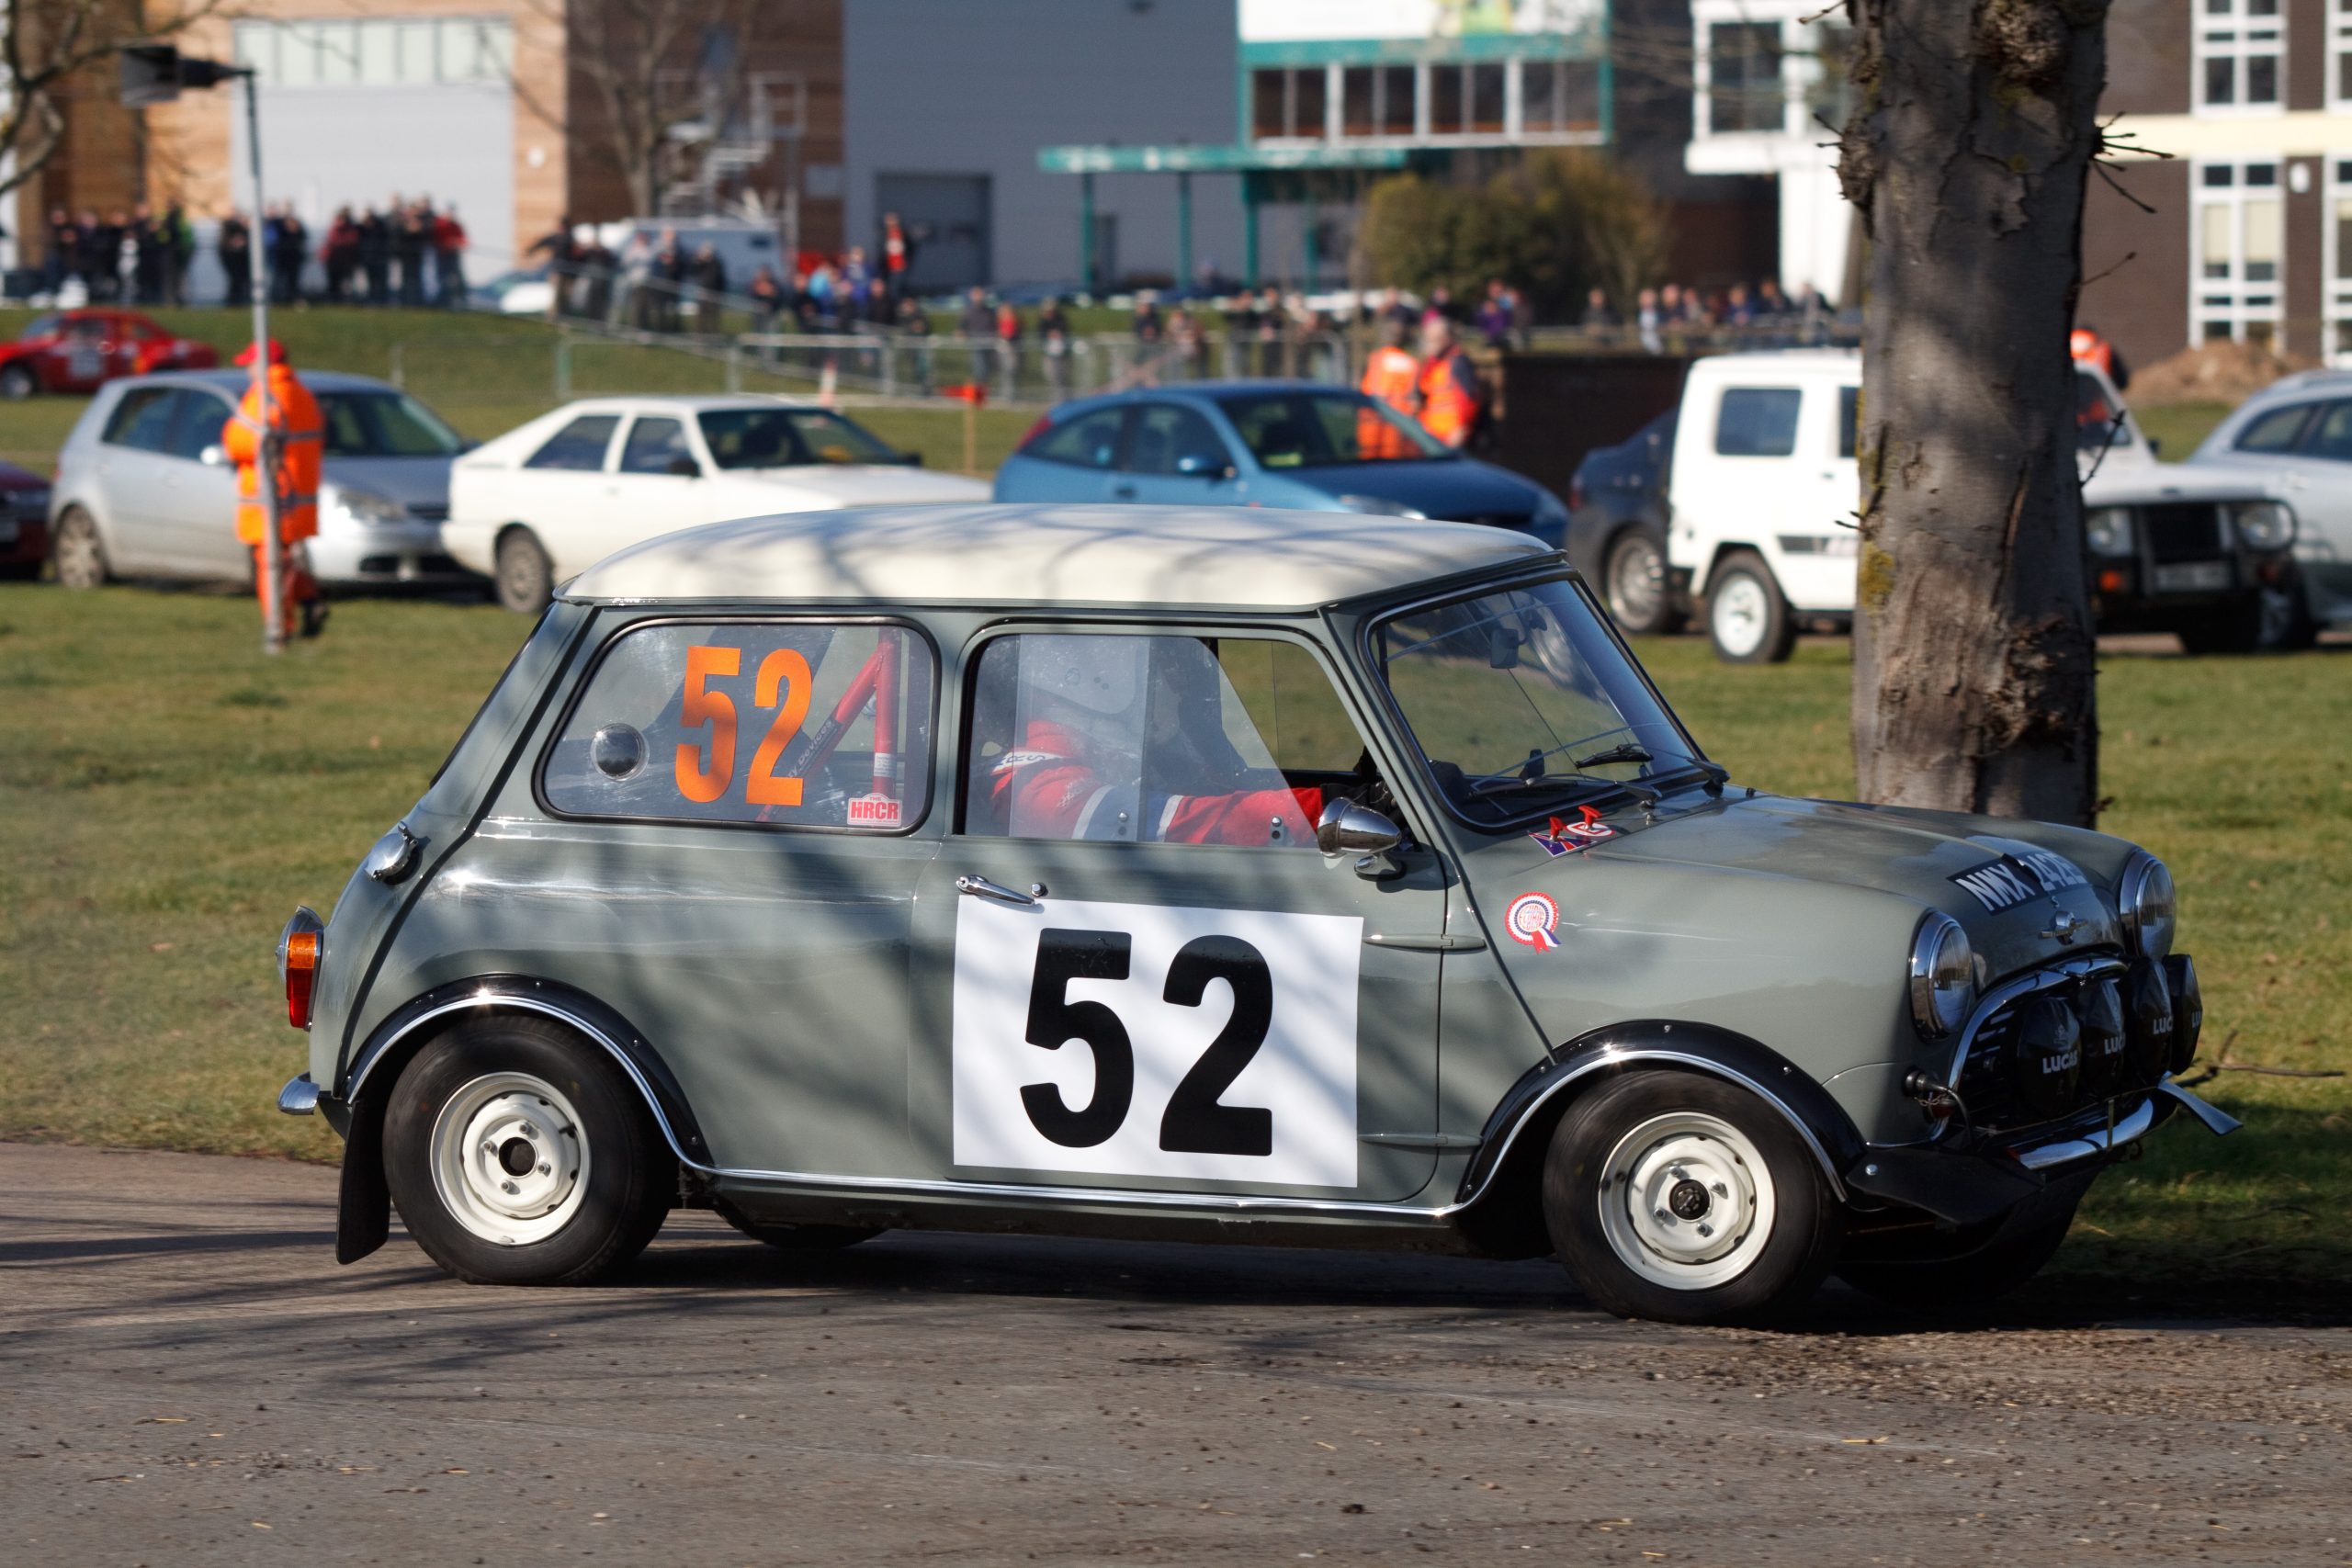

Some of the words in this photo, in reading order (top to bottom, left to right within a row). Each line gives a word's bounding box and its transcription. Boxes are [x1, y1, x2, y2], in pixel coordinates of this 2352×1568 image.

[675, 646, 813, 807] 52
[851, 801, 899, 819] HRCR
[1955, 863, 2035, 911] NMX
[1020, 928, 1272, 1156] 52
[2042, 1050, 2078, 1074] LUCAS
